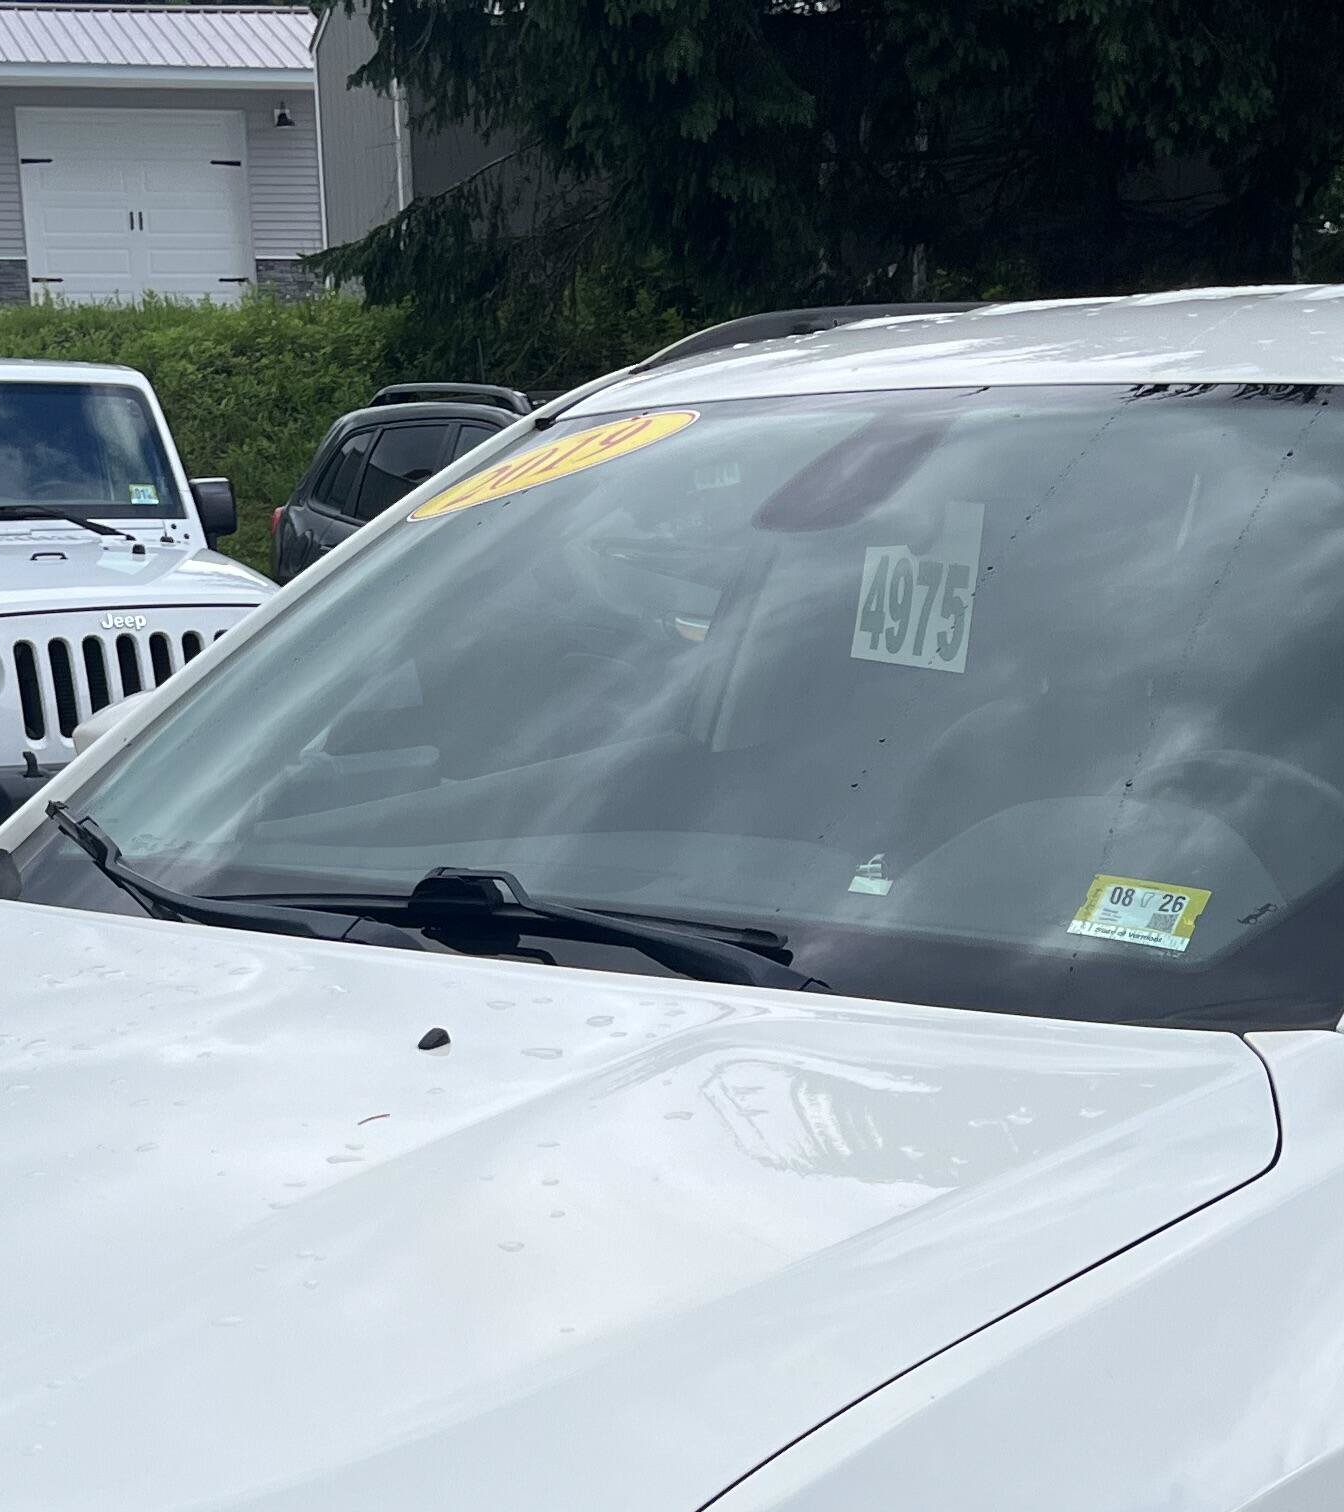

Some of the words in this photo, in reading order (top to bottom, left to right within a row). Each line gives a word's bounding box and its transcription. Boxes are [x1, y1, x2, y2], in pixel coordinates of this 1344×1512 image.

[439, 419, 654, 510] 2019
[100, 613, 147, 631] Jeep
[859, 555, 971, 662] 4975
[1110, 886, 1135, 907] 08
[1158, 893, 1186, 913] 26
[1128, 931, 1163, 943] Vermont
